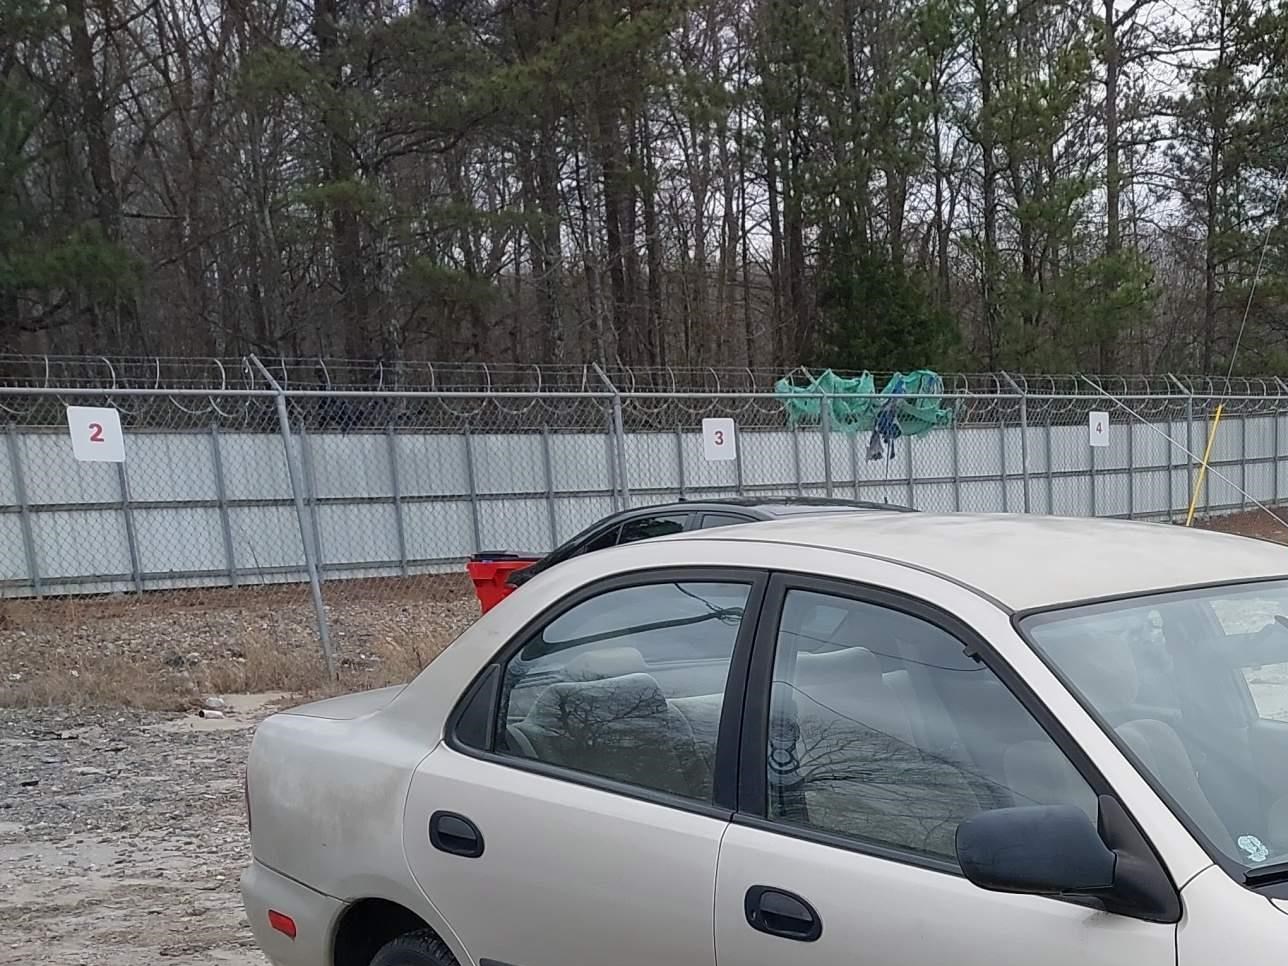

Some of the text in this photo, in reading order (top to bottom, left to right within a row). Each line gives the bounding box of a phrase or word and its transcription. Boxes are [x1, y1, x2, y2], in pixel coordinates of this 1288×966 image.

[88, 423, 105, 442] 2
[1095, 421, 1104, 434] 4
[714, 430, 724, 445] 3
